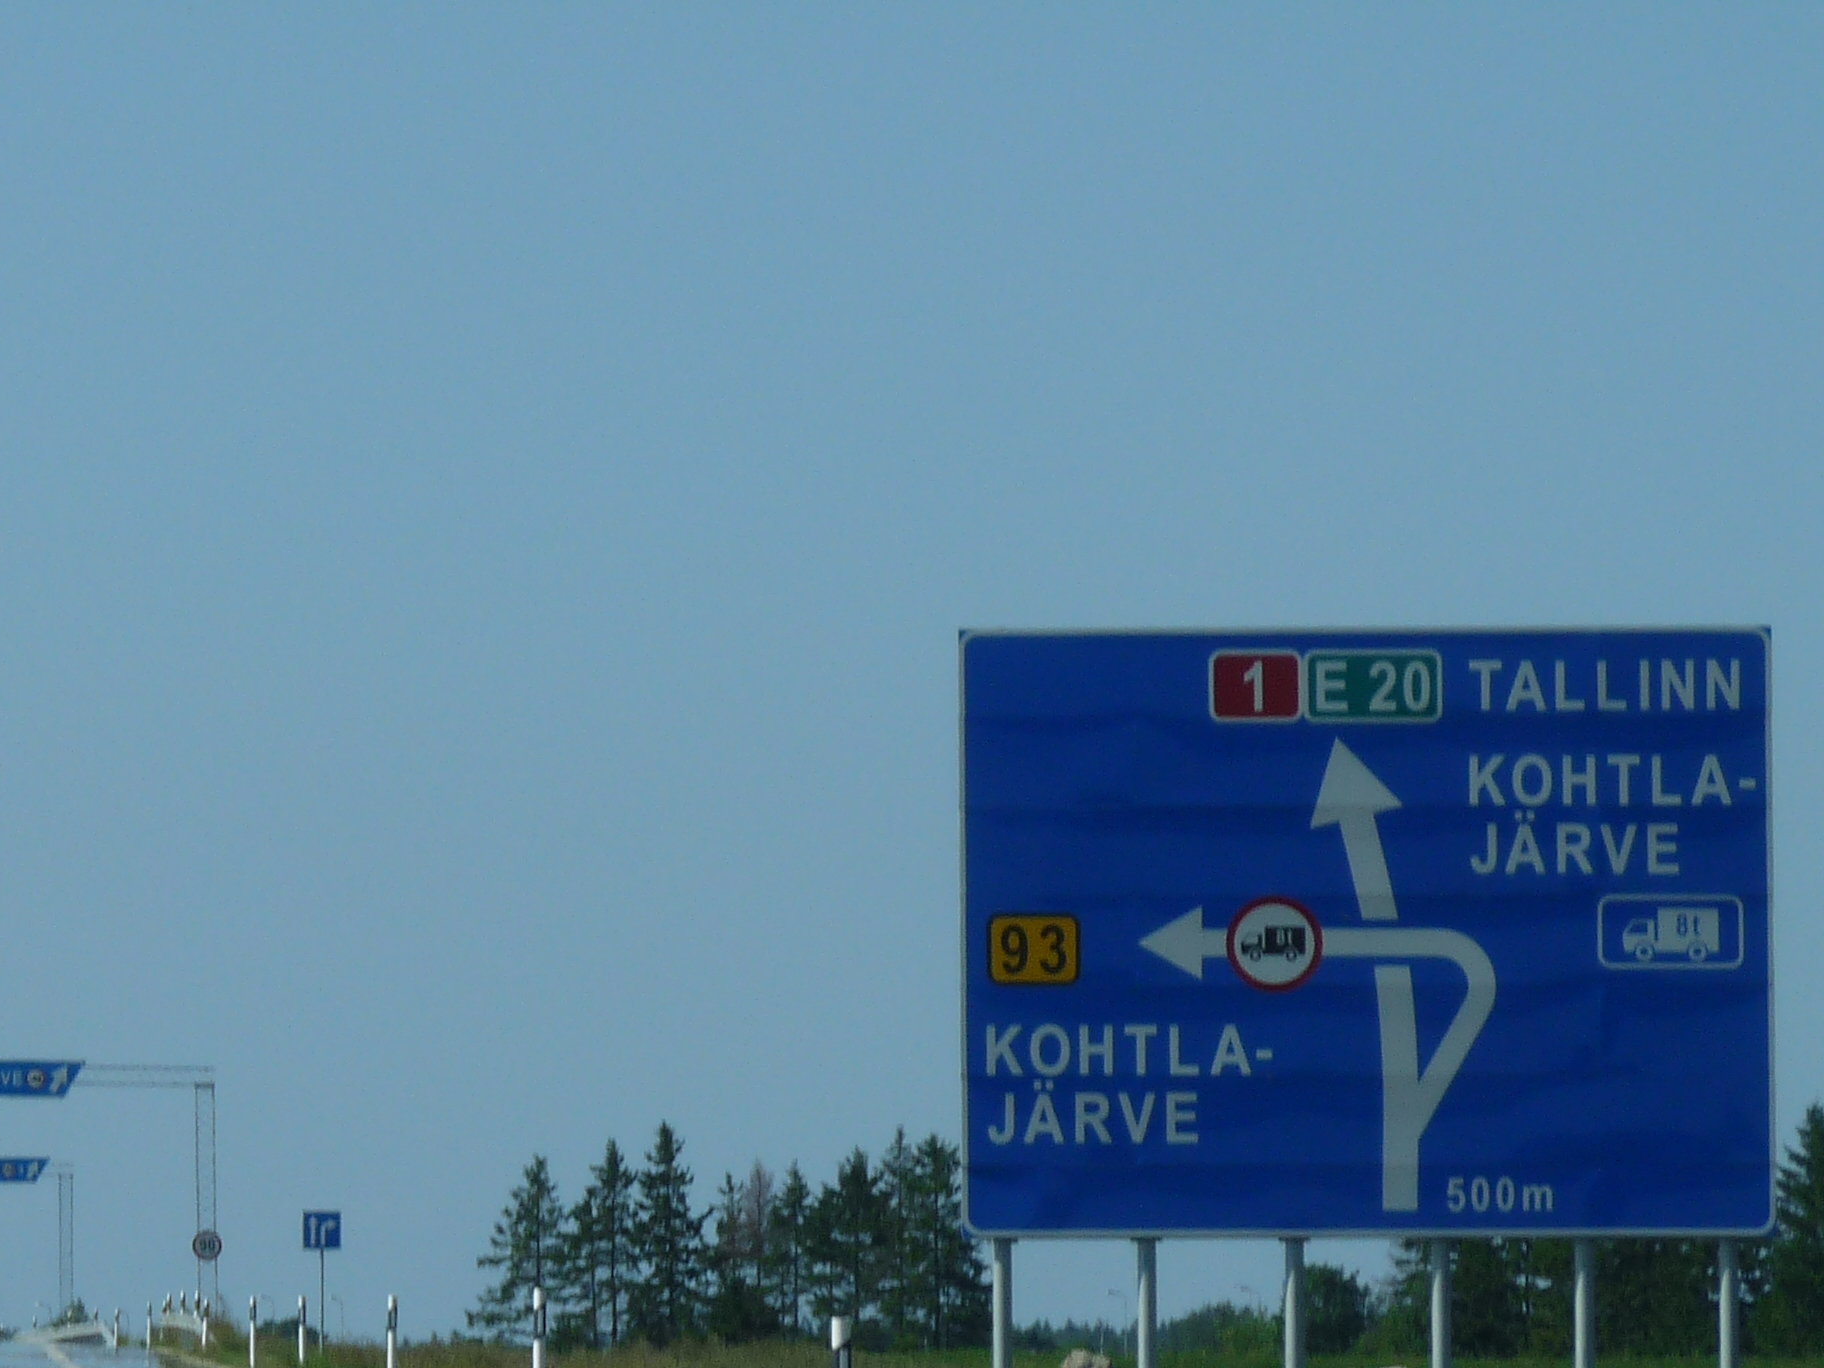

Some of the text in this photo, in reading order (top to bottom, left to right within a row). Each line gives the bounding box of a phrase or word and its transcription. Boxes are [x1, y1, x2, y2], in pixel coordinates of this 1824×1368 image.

[1242, 659, 1741, 712] 1 E 20 TALLINN
[1468, 754, 1757, 806] KOHTLA-
[1470, 810, 1680, 875] JÄRVE
[1000, 925, 1067, 974] 93
[986, 1023, 1273, 1077] KOHTLA-
[988, 1079, 1199, 1145] JÄRVE
[1447, 1176, 1554, 1213] 500m
